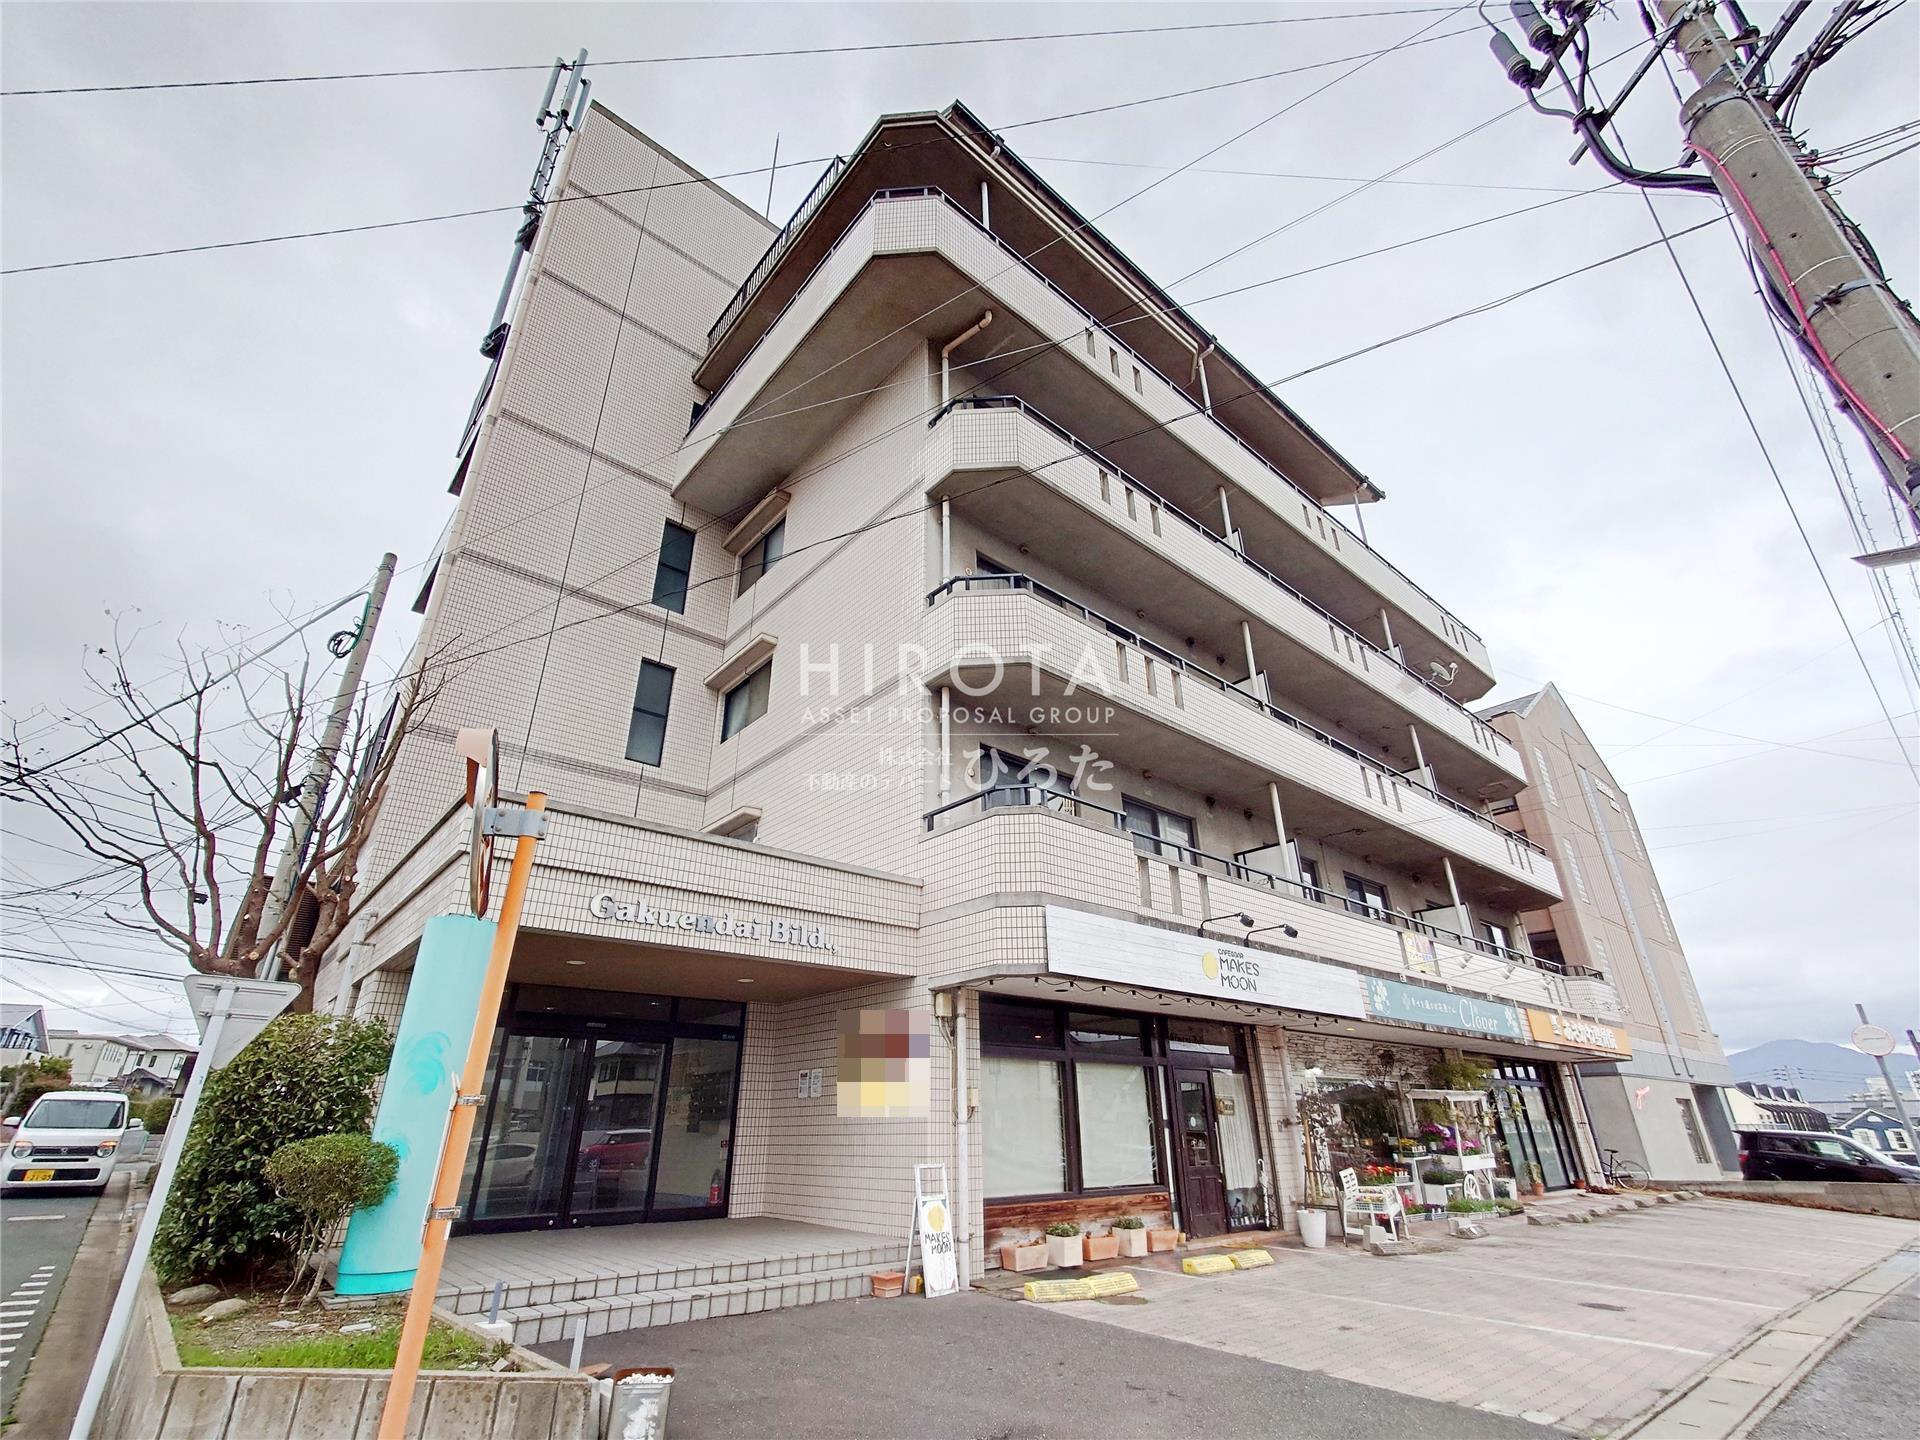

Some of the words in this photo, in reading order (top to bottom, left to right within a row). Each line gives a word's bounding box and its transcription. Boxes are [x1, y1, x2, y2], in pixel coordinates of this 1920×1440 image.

[590, 892, 760, 941] Gakuendai
[1219, 956, 1260, 977] MAKES
[1220, 973, 1257, 993] MOON
[1459, 998, 1498, 1032] Clover
[924, 1231, 950, 1244] MAKES
